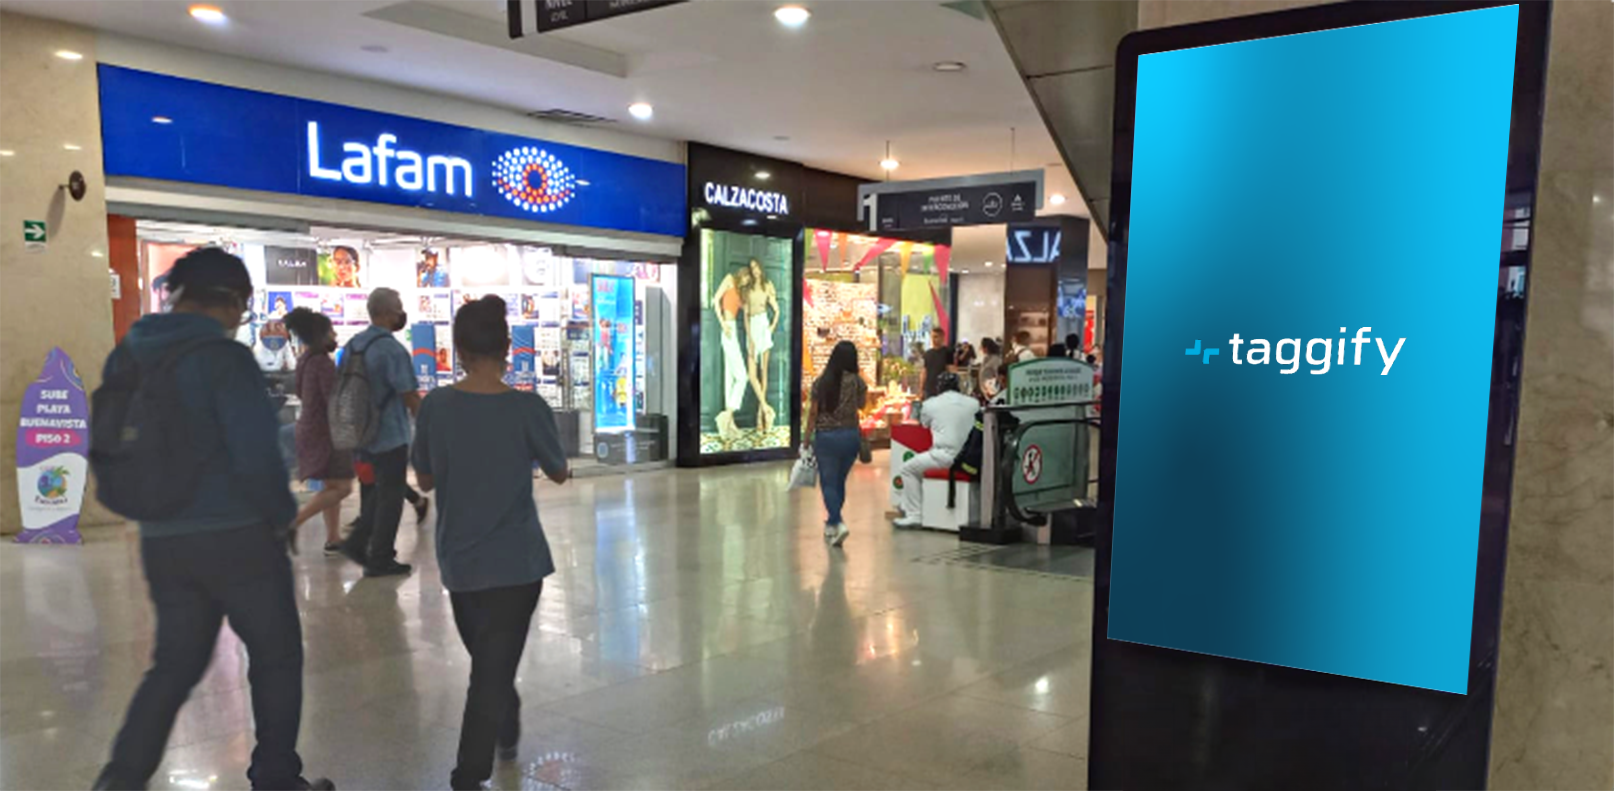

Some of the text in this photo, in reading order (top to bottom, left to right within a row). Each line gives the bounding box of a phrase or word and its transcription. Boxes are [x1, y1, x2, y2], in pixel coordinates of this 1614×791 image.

[307, 121, 472, 197] Lafam
[704, 181, 789, 215] CALZACOSTA
[863, 193, 878, 231] 1
[1228, 326, 1407, 376] taggify
[40, 389, 69, 400] SUBE
[36, 404, 71, 414] PLAYA
[19, 417, 87, 429] BUENAVISTA
[35, 433, 71, 444] PISO 2
